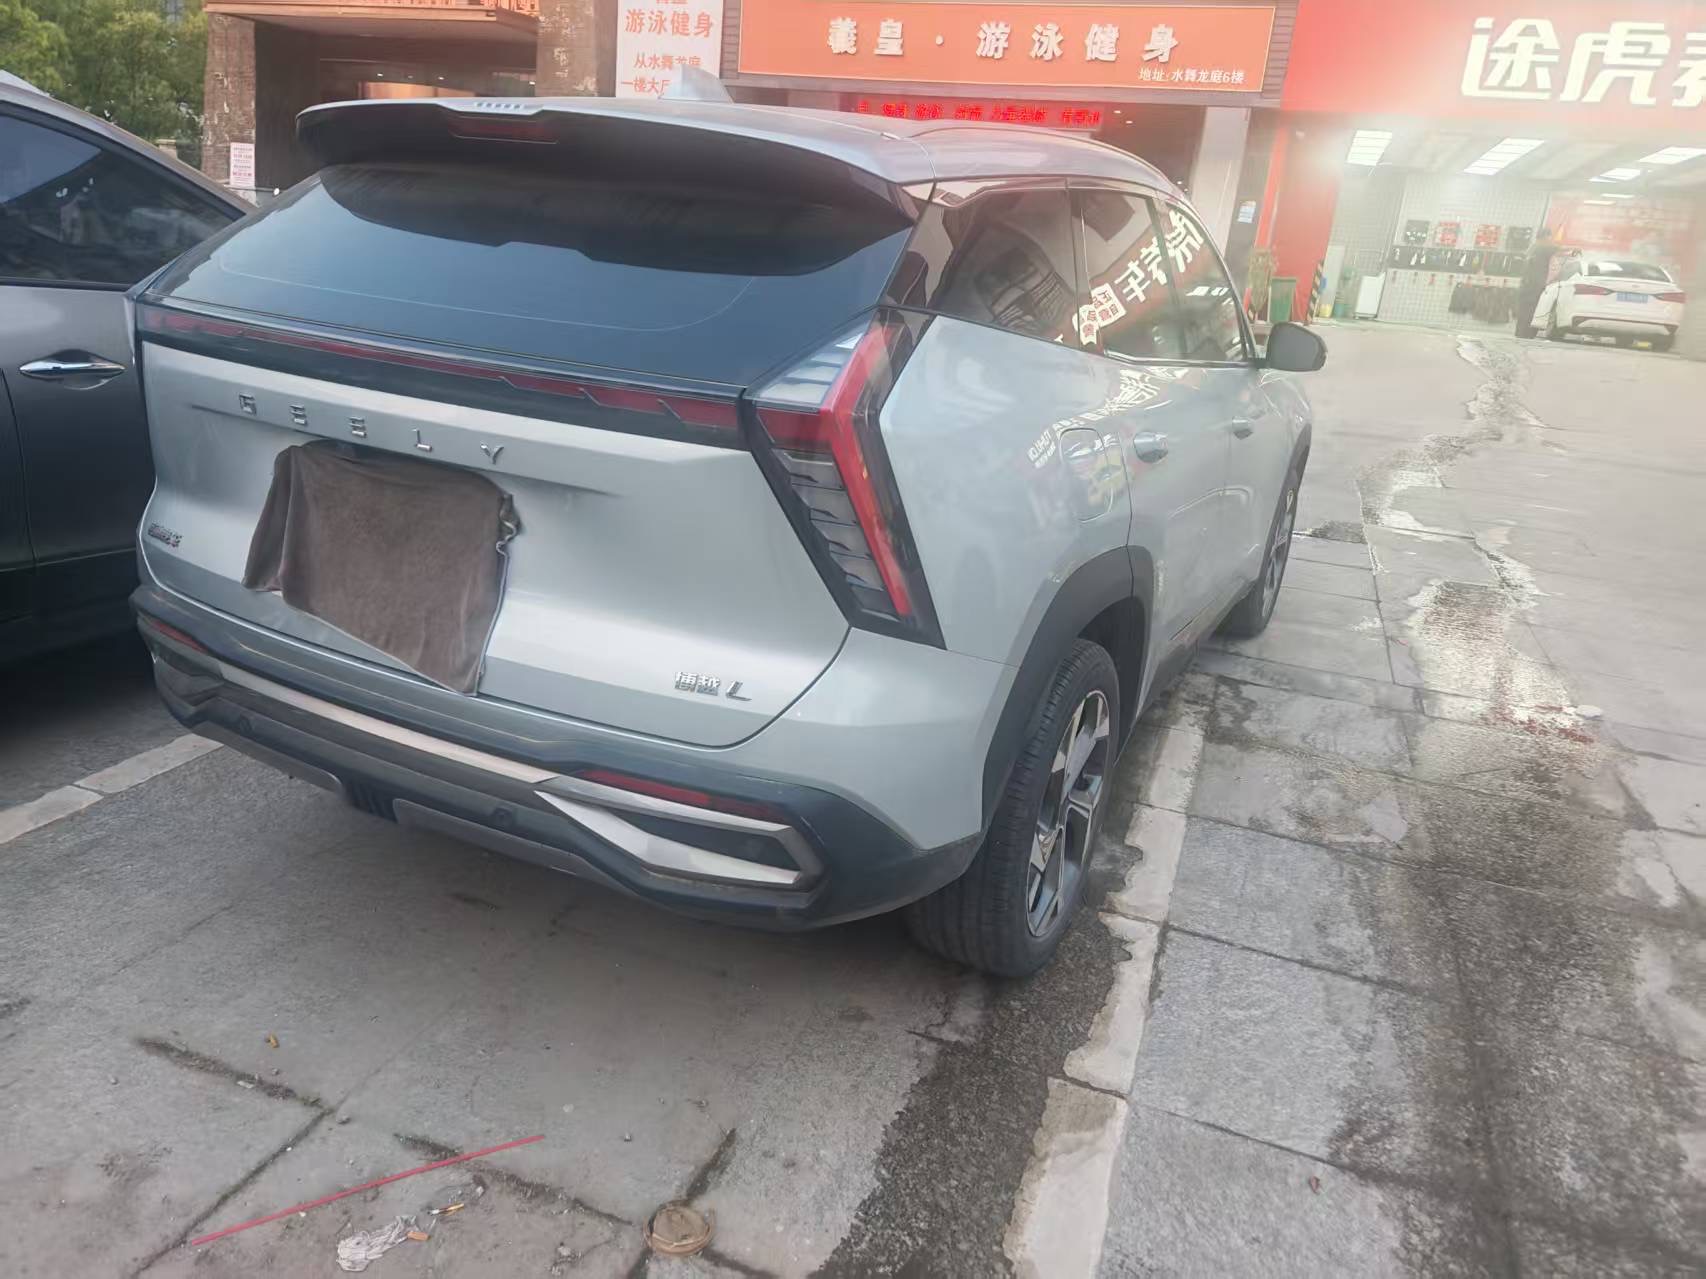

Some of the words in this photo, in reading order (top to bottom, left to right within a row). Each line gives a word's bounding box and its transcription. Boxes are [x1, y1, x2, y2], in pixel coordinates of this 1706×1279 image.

[625, 9, 713, 37] 游泳健身
[238, 391, 505, 466] GEELY
[725, 680, 753, 701] L
